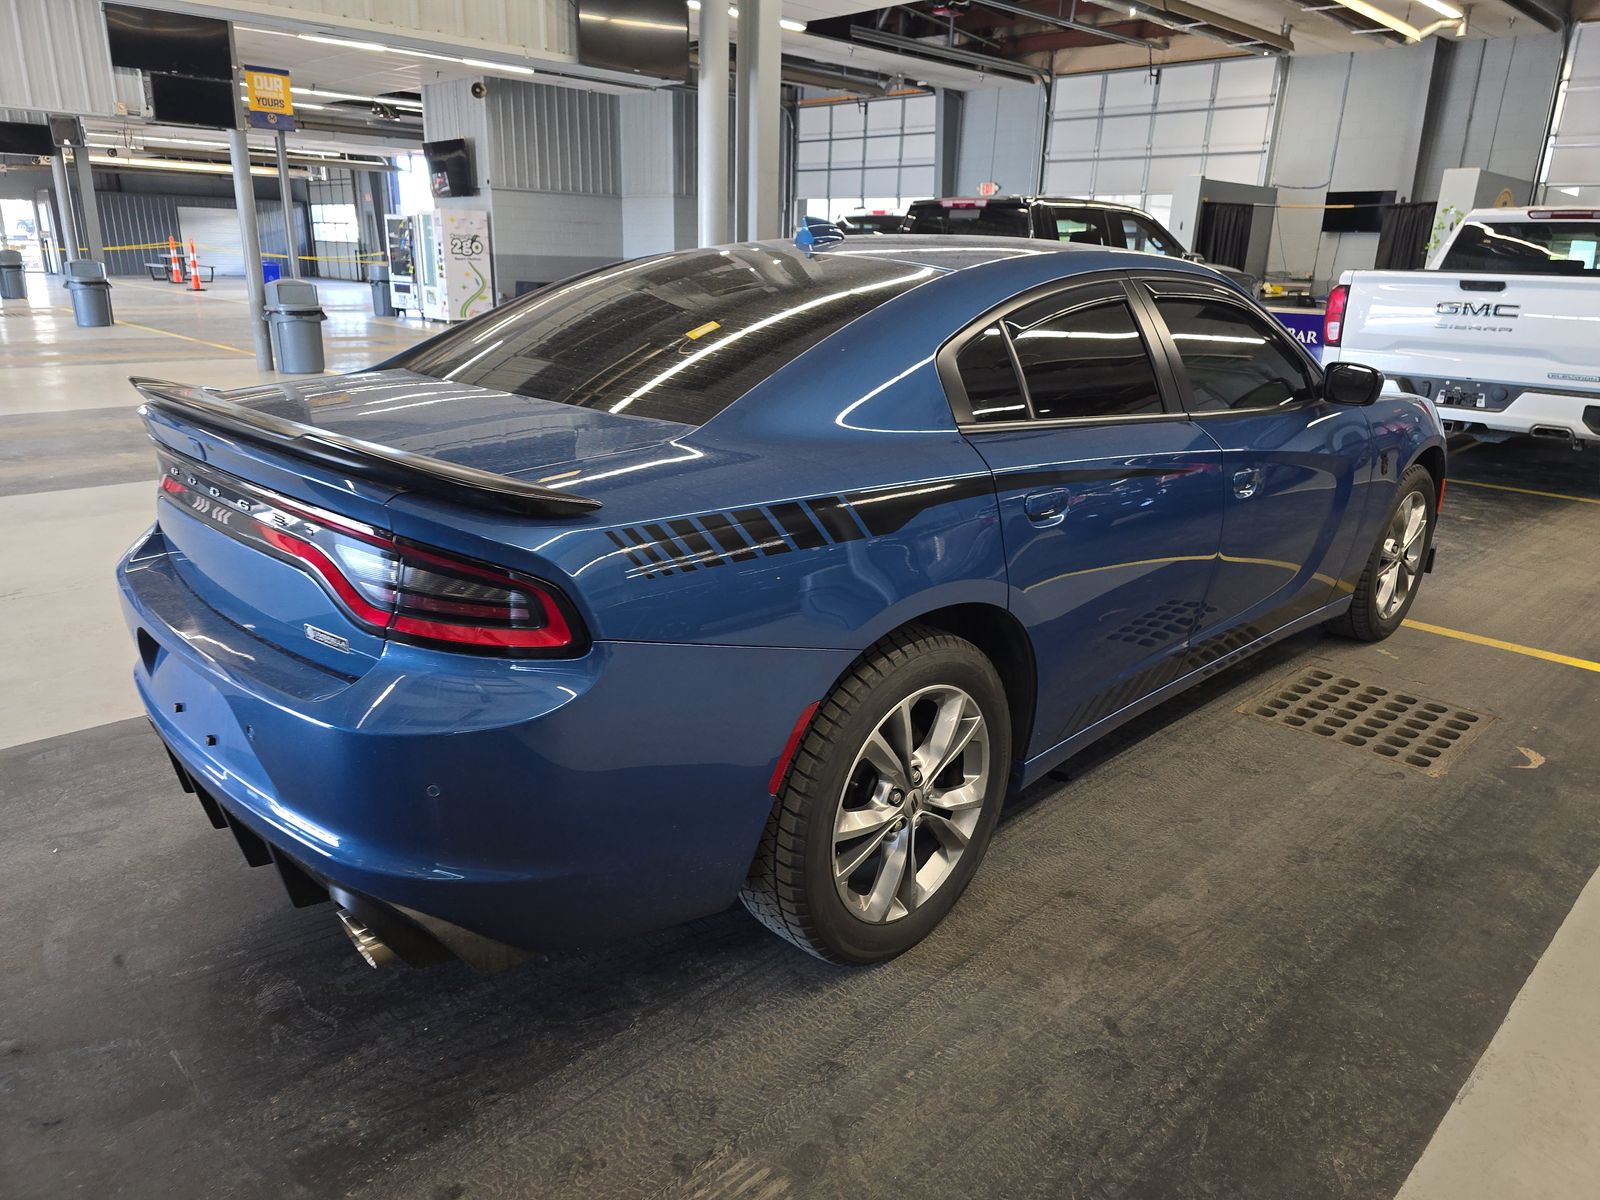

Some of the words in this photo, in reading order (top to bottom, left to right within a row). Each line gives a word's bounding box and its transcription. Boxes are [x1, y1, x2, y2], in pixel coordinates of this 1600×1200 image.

[253, 75, 283, 91] OUR
[255, 96, 285, 109] YOURS
[1437, 301, 1520, 318] GMC
